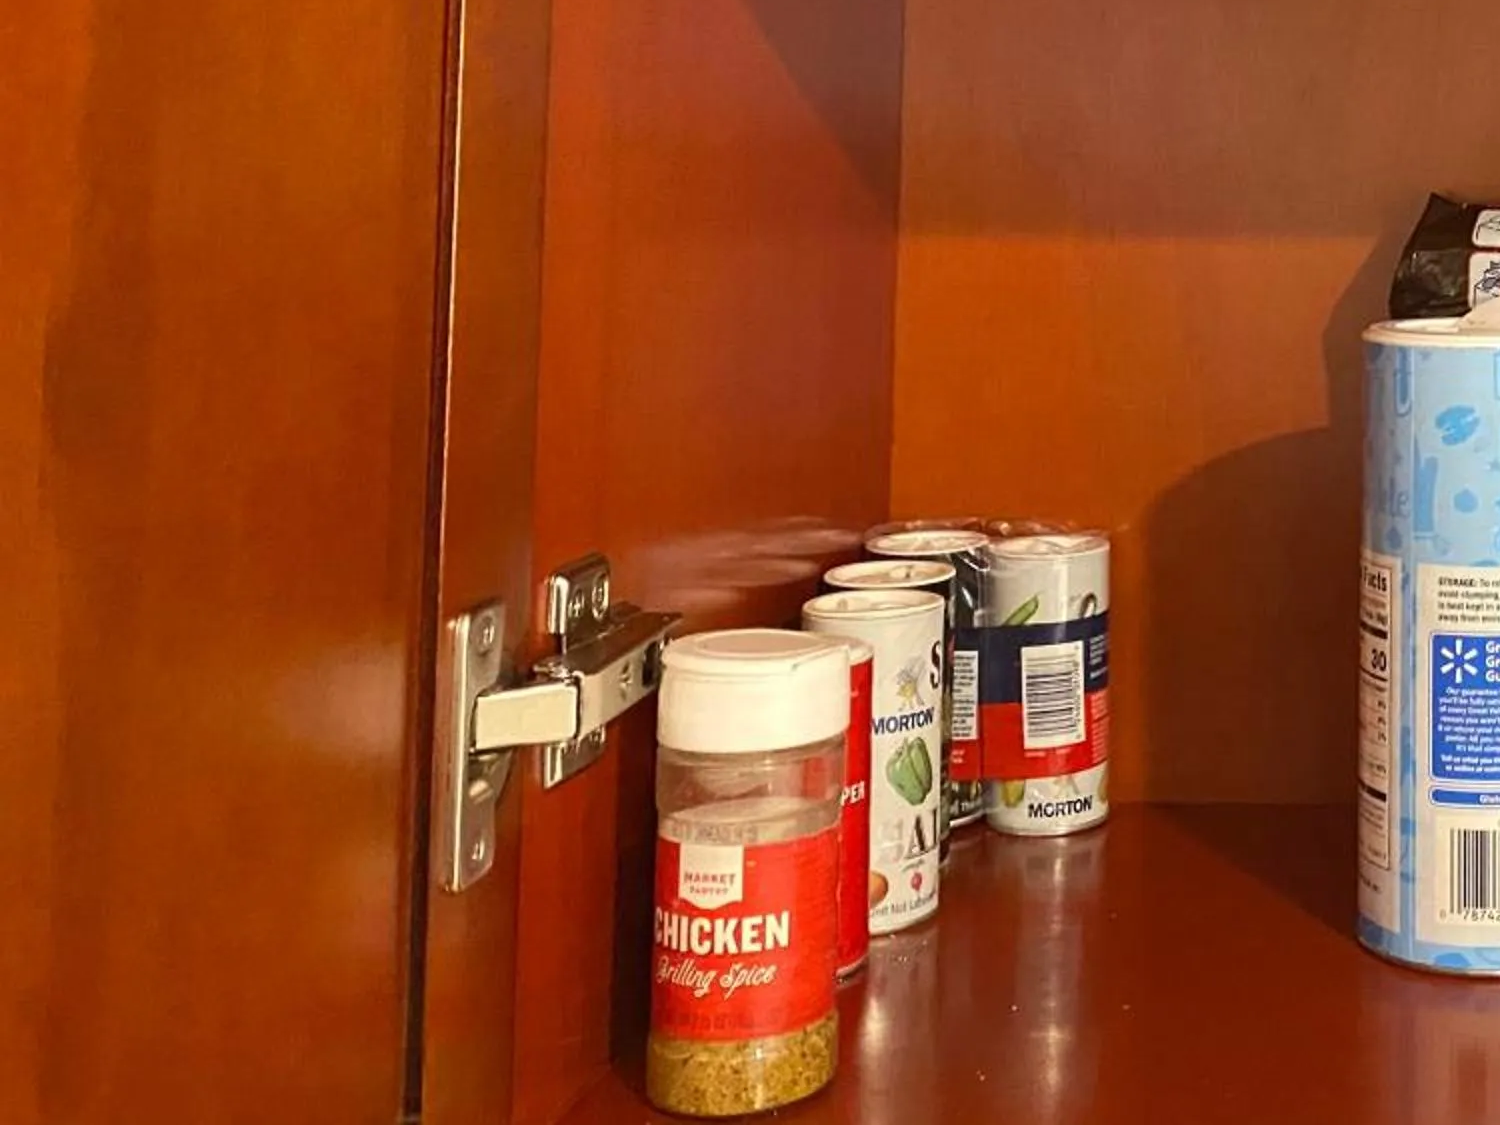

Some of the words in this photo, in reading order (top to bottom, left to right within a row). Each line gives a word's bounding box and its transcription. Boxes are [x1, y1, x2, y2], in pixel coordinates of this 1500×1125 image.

[871, 706, 934, 735] MORTON
[1028, 795, 1093, 818] MORTON
[684, 872, 736, 885] MARKET
[653, 906, 790, 955] CHICKEN
[719, 961, 778, 1001] Spice
